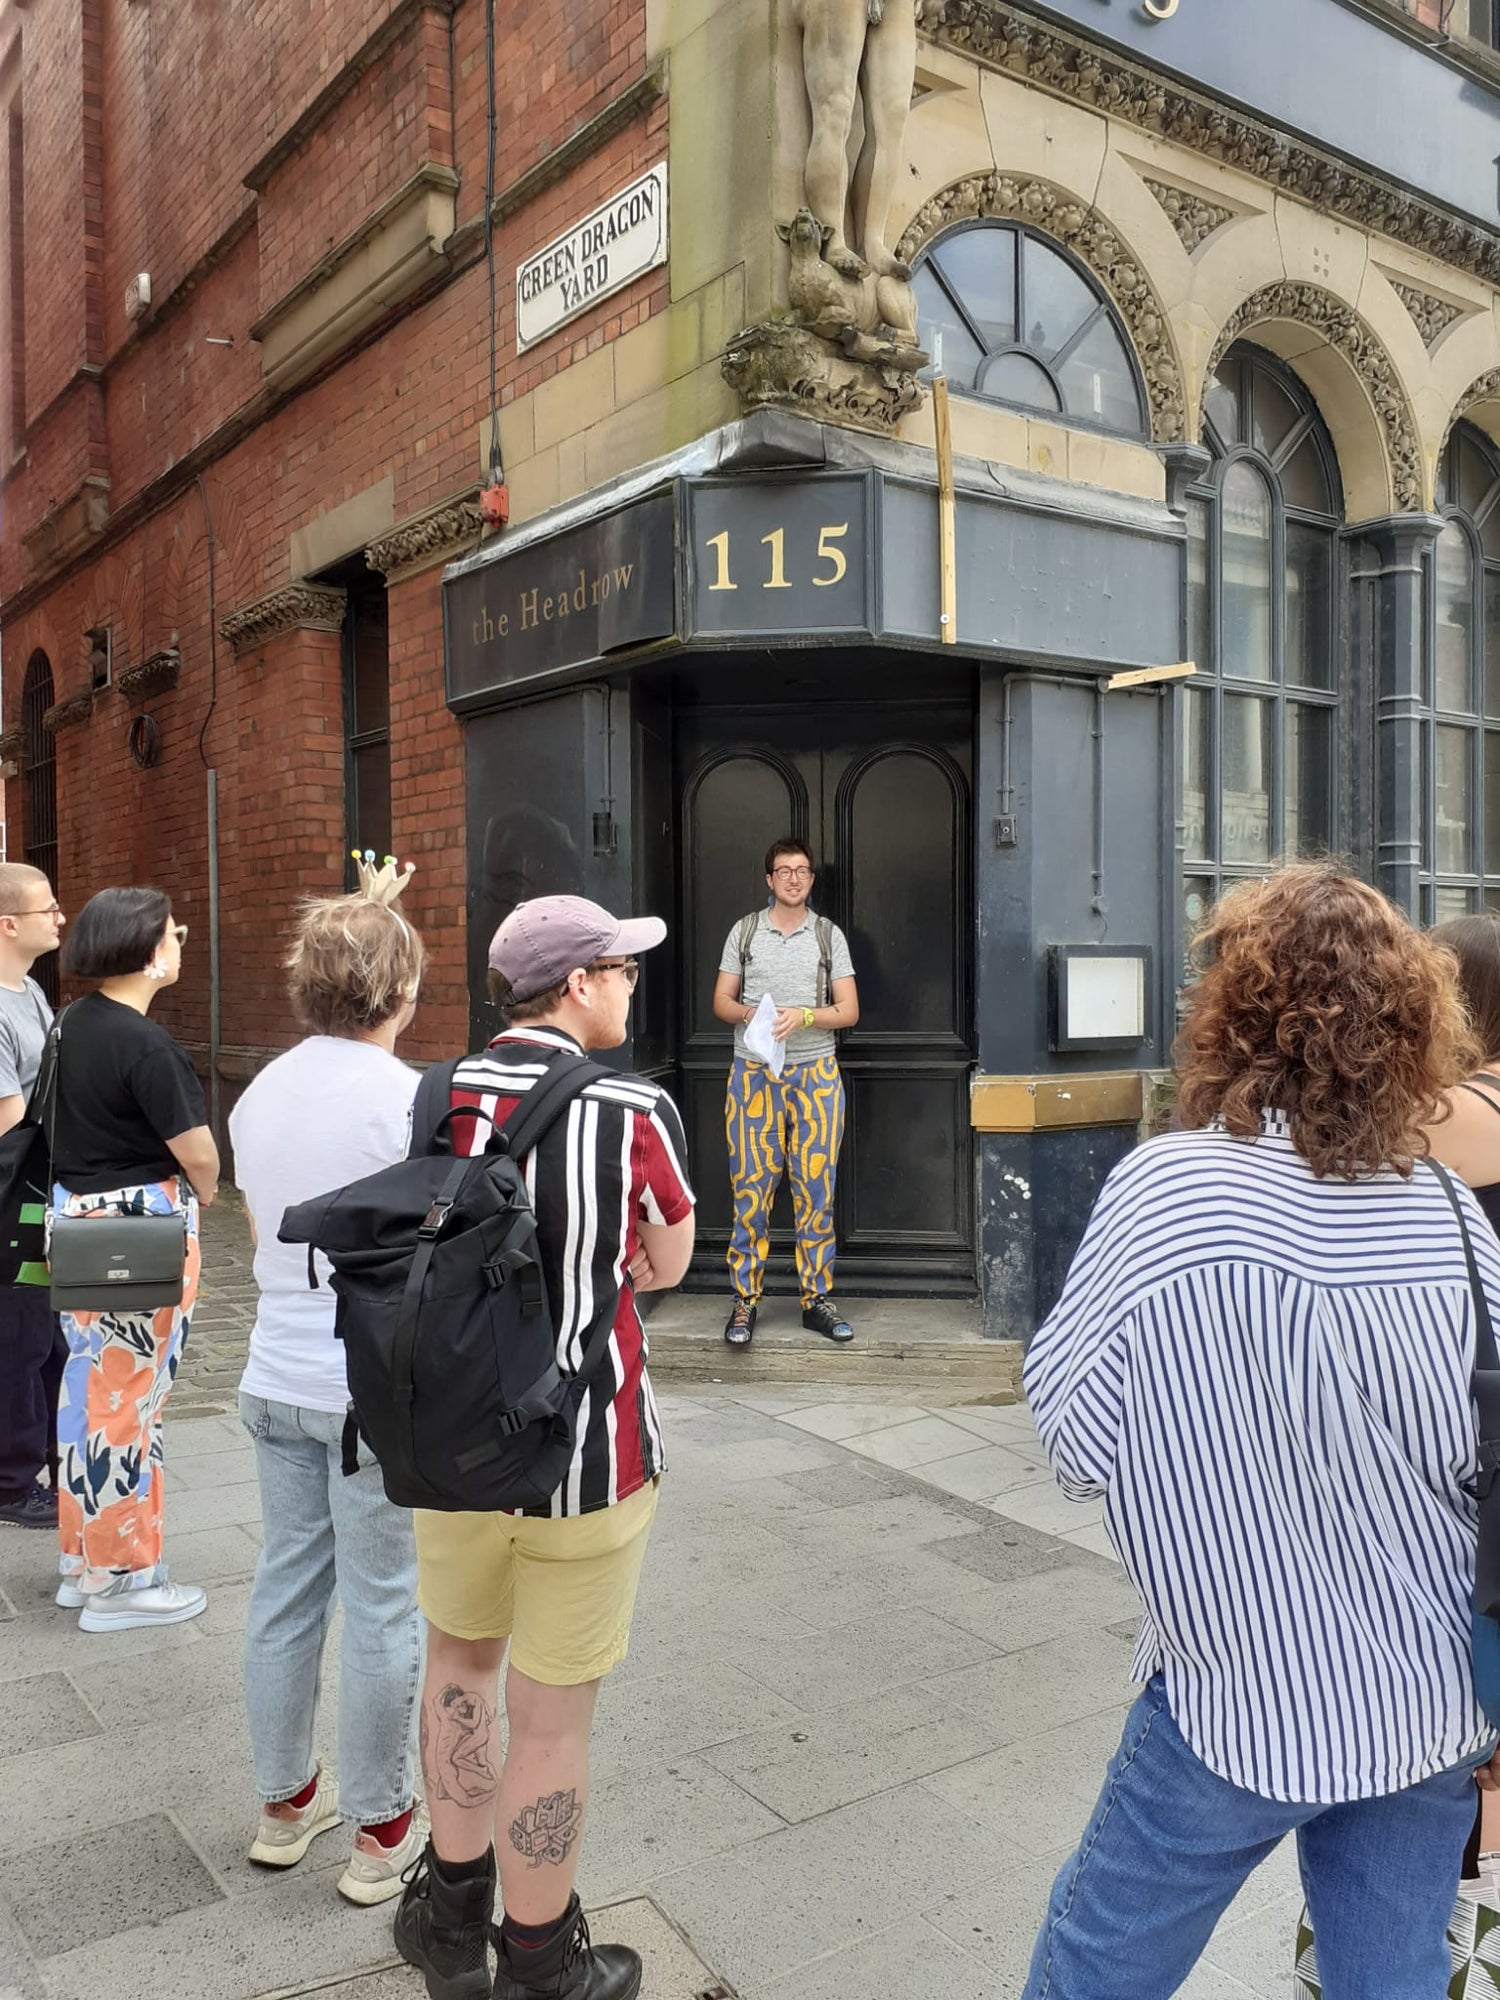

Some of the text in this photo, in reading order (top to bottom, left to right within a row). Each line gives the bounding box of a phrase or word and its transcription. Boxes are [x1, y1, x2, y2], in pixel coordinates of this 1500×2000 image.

[521, 183, 654, 303] GREEN DRAGON
[560, 254, 608, 311] YARD
[705, 521, 849, 590] 115
[472, 564, 633, 646] the Headrow
